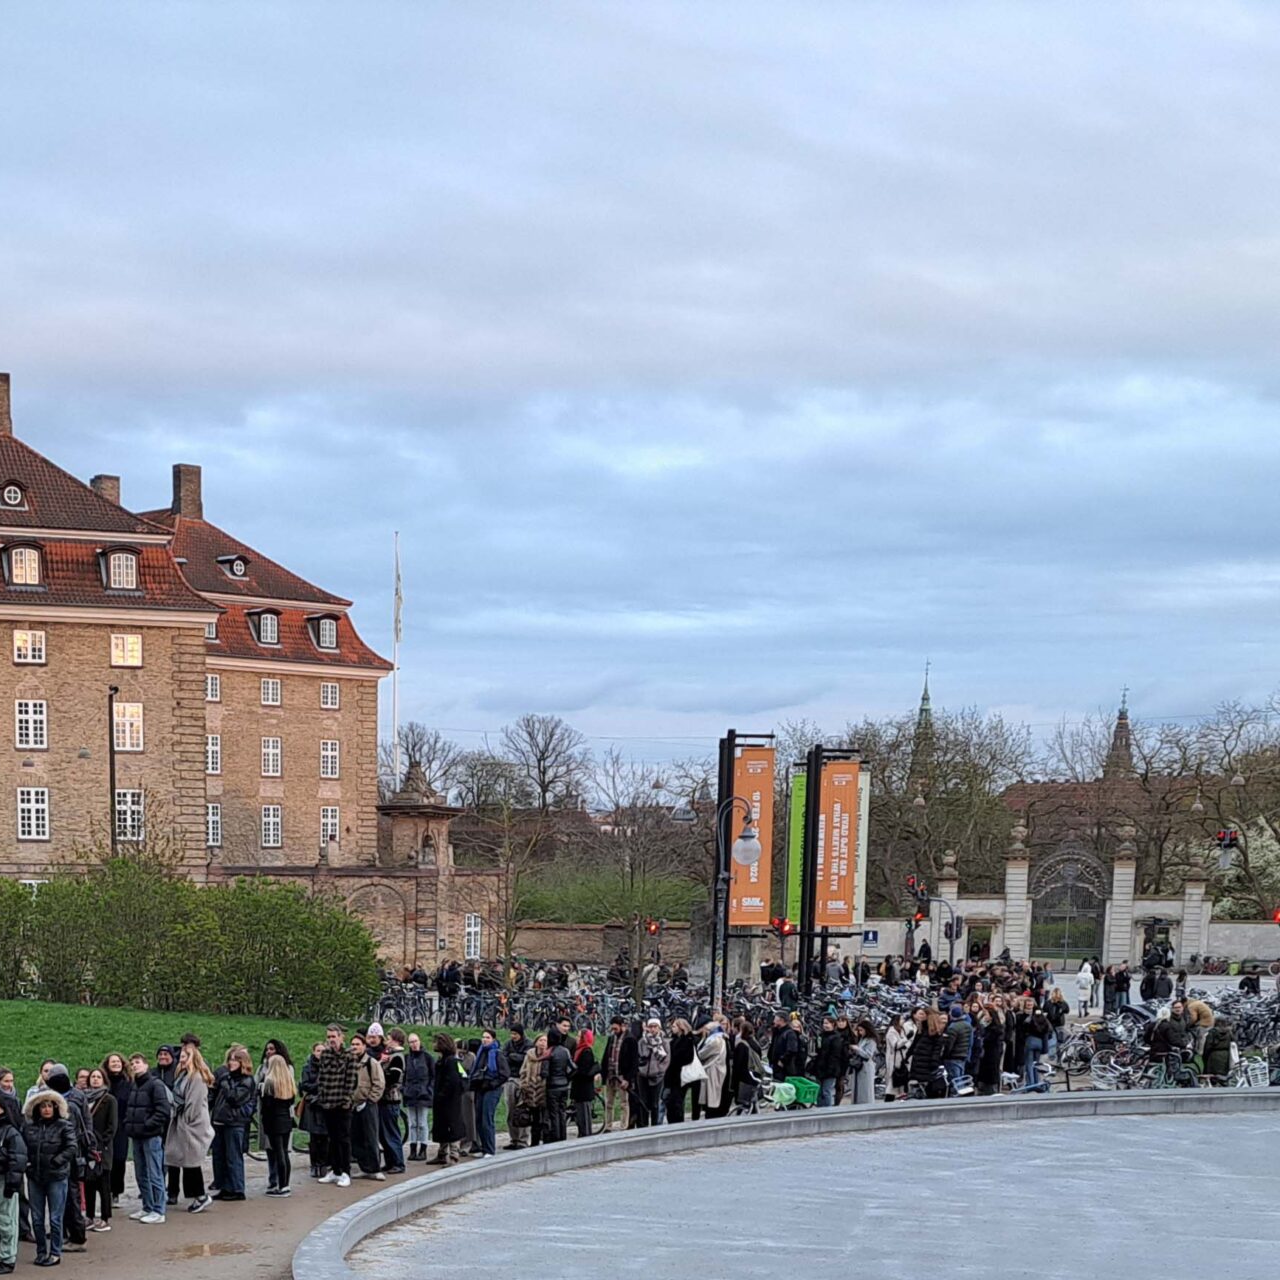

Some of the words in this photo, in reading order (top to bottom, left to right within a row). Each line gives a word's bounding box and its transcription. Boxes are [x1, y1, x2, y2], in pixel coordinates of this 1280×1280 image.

[753, 791, 760, 801] 10
[752, 802, 760, 819] FEB
[750, 861, 758, 883] 2024
[831, 858, 839, 873] THE
[830, 875, 838, 891] EYE
